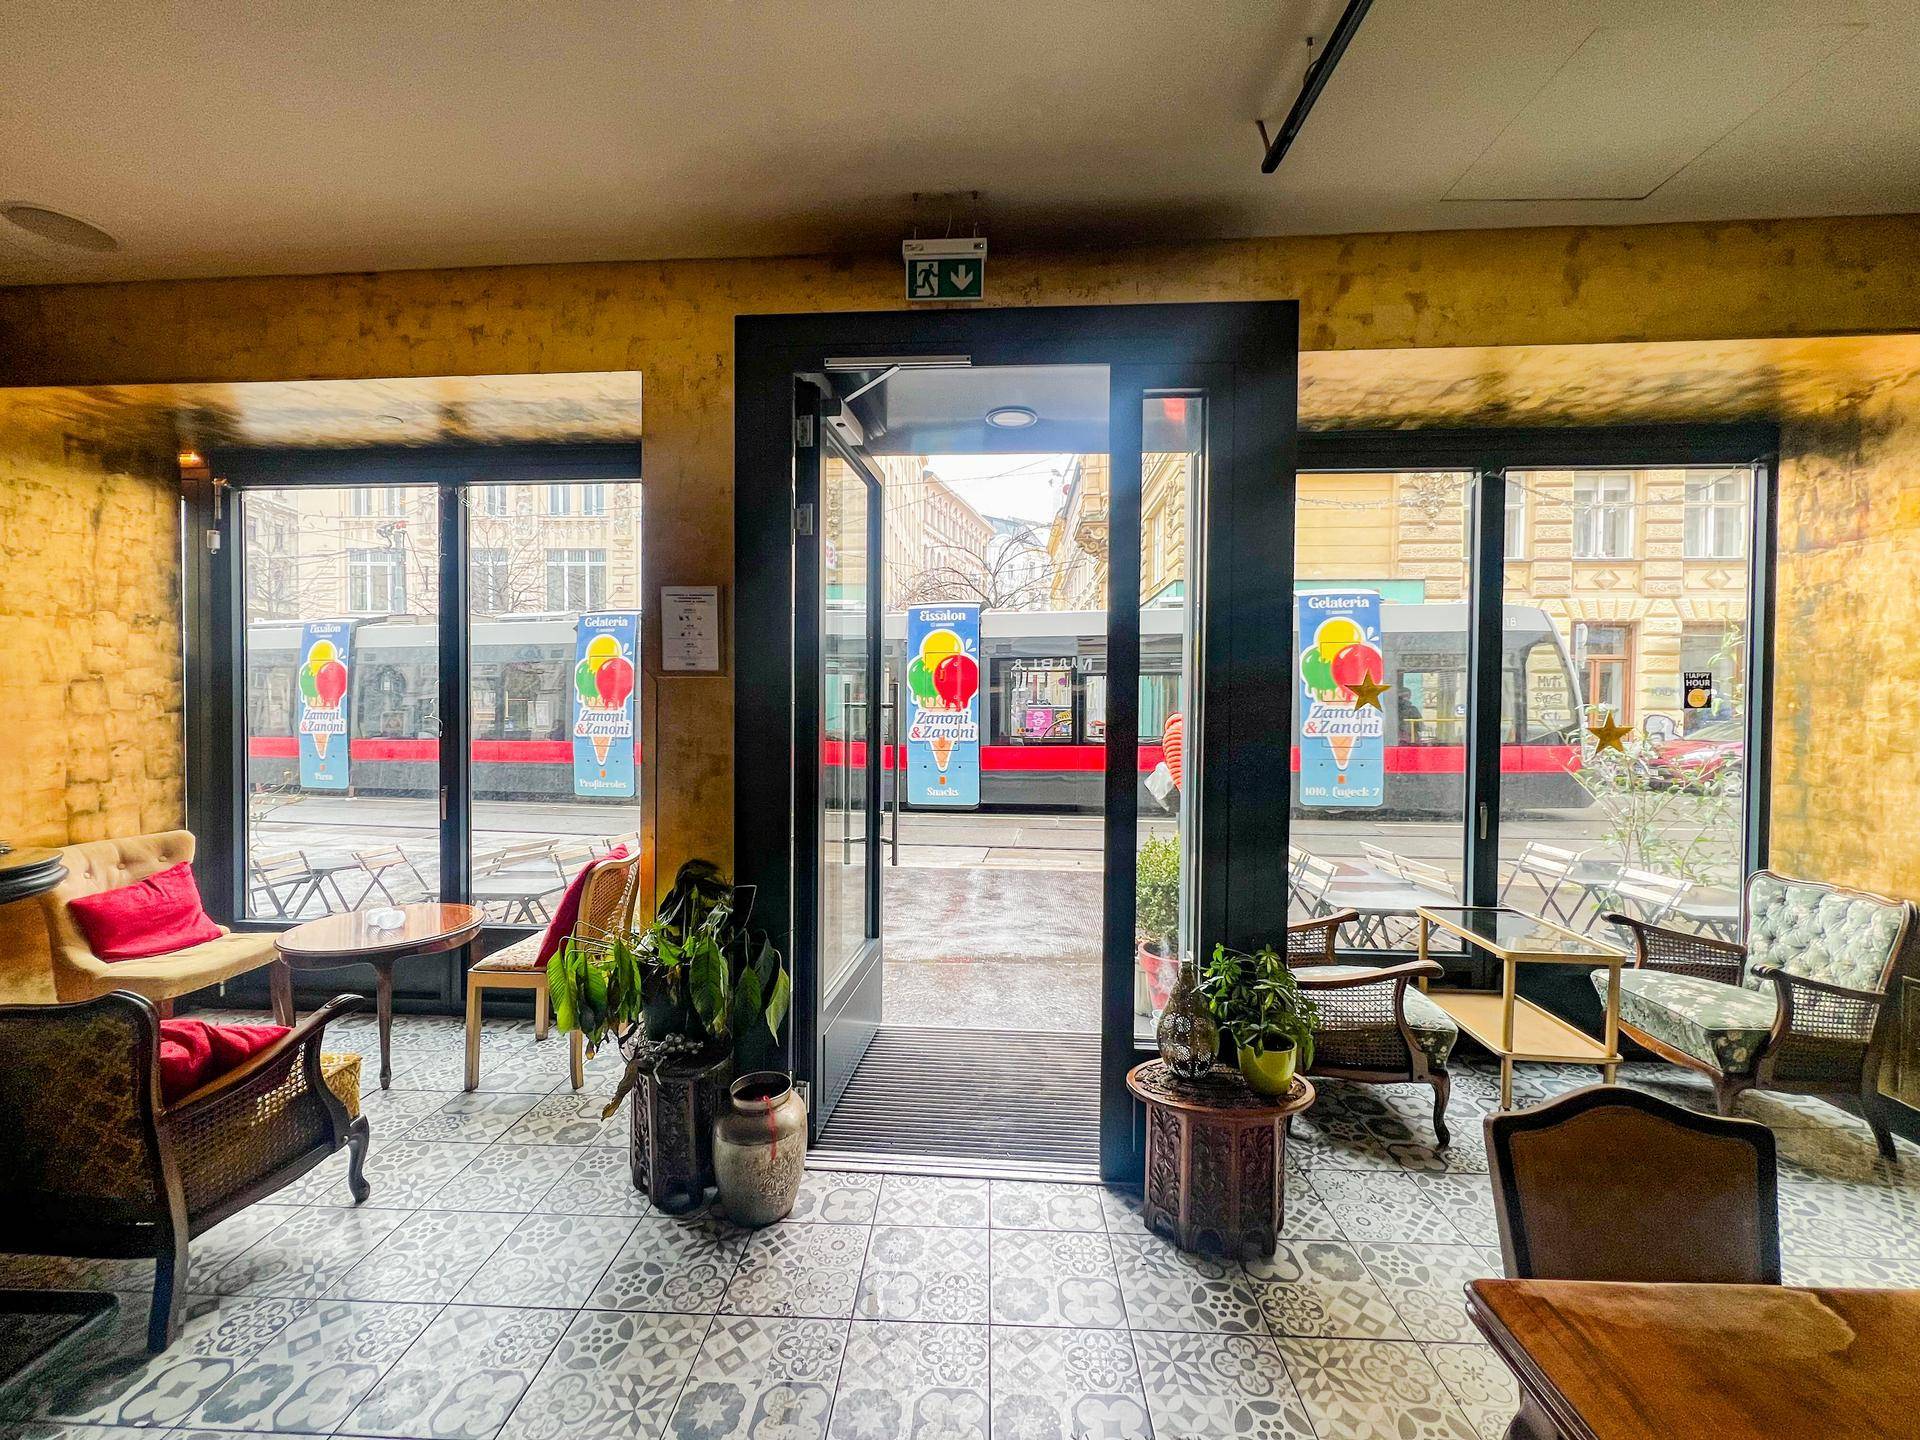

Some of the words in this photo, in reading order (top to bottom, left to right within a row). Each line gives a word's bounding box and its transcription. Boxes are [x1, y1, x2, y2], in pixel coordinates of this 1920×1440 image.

[1308, 595, 1370, 609] Gelateria
[585, 616, 628, 627] Gelateria
[920, 610, 966, 621] Eissalon
[305, 709, 340, 721] Zanoni
[580, 710, 625, 722] Zanoni
[917, 711, 969, 725] Zanoni
[1312, 705, 1372, 719] Zanoni
[927, 786, 959, 797] Snacks
[1372, 786, 1380, 797] 7
